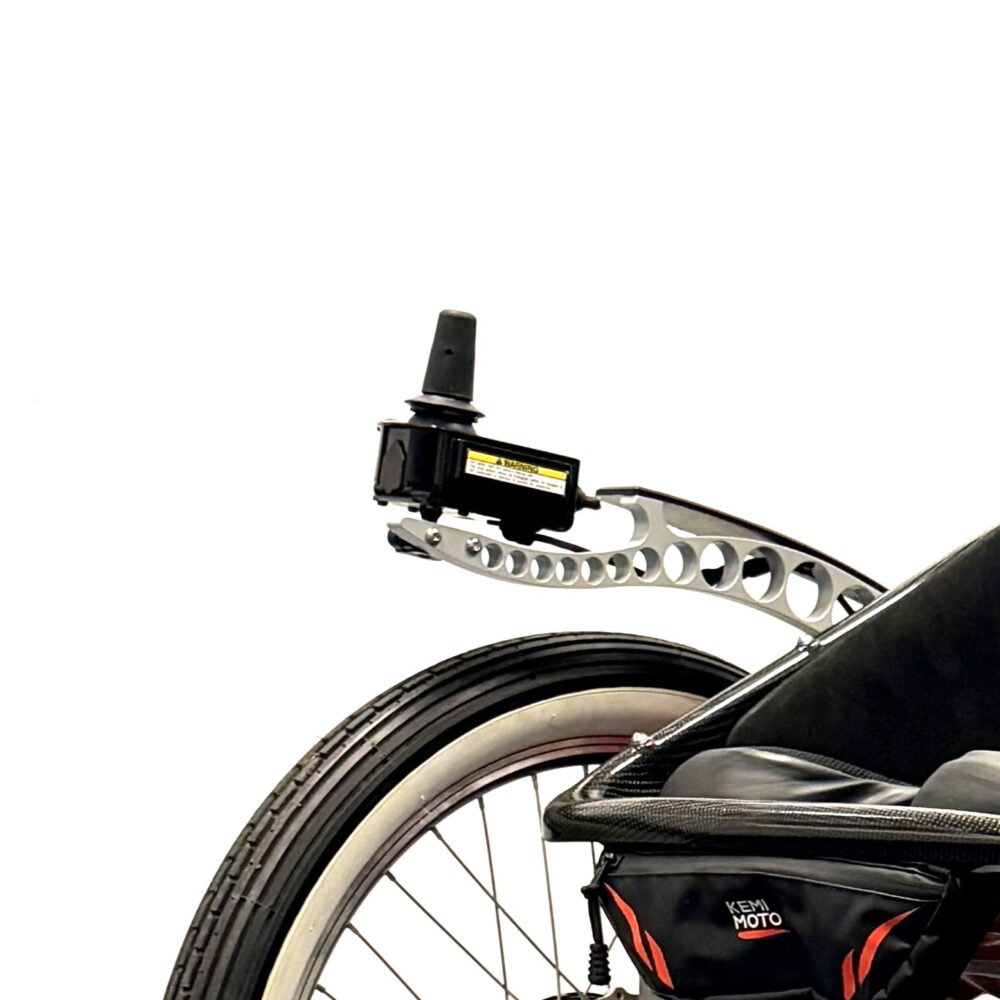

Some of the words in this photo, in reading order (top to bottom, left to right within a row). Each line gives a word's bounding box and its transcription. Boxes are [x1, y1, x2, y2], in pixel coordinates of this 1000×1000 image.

[503, 459, 539, 475] WARNING
[725, 899, 770, 914] KEMI
[732, 912, 782, 930] MOTO
